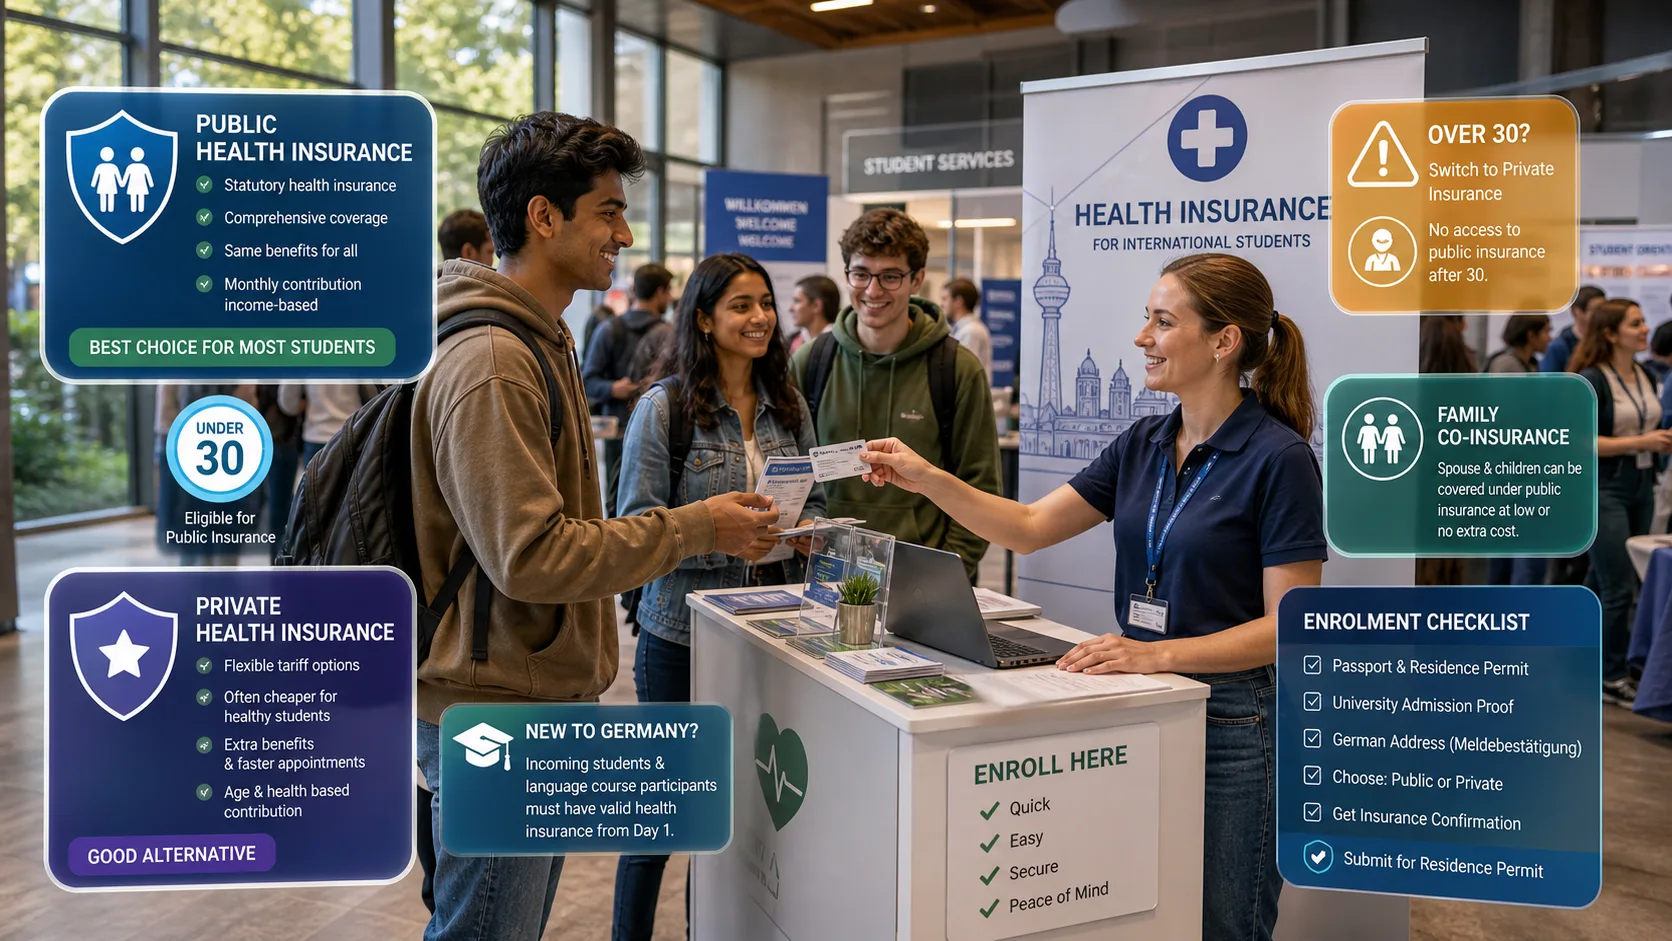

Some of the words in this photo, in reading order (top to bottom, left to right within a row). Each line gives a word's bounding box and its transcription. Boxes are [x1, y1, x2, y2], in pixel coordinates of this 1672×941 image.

[863, 153, 936, 175] STUDENT
[937, 149, 1015, 171] SERVICES
[723, 197, 808, 214] WILLKOMMEN
[1075, 200, 1171, 227] HEALTH
[1180, 195, 1331, 224] INSURANCE
[1092, 237, 1119, 251] FOR
[1122, 235, 1232, 251] INTERNATIONAL
[1235, 233, 1311, 249] STUDENTS
[974, 754, 1064, 785] ENROLL
[1070, 744, 1128, 772] HERE
[1009, 796, 1051, 817] Quick
[1010, 831, 1044, 849] Easy
[1009, 862, 1059, 881] Secure
[1009, 894, 1053, 913] Peace
[1056, 887, 1071, 904] of
[1075, 880, 1109, 901] Mind
